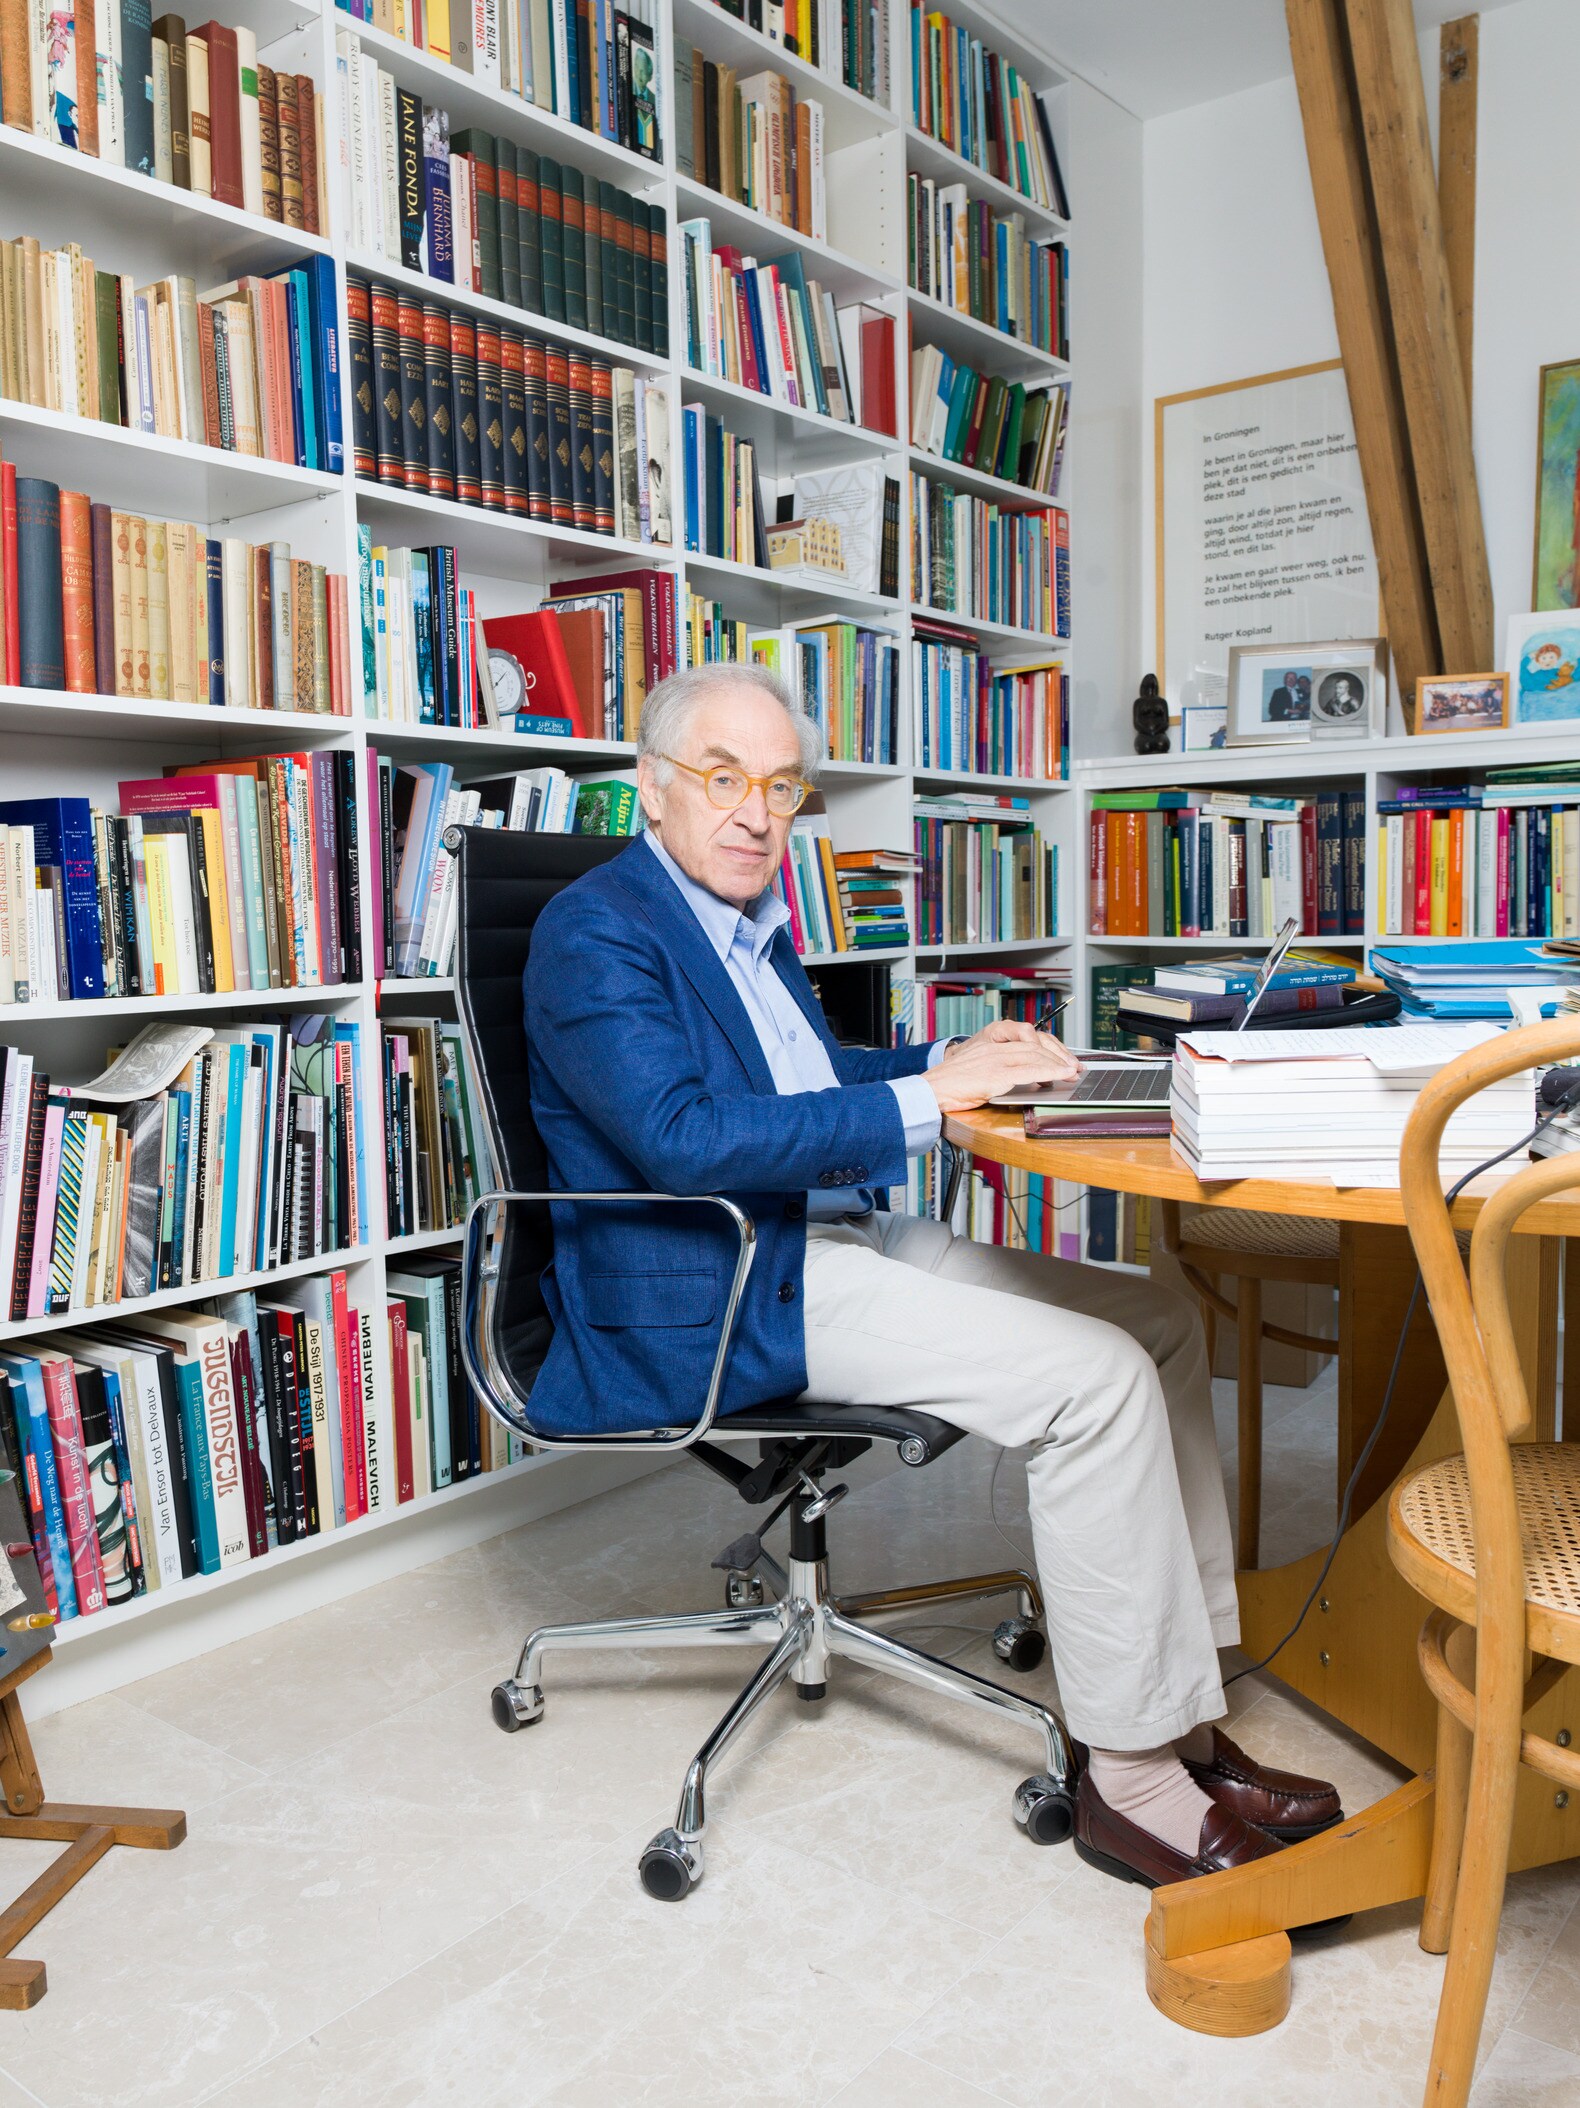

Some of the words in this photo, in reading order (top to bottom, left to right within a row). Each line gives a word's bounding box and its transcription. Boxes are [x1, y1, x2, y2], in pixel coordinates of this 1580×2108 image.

[487, 27, 496, 60] BLAIR
[350, 44, 360, 86] ROMY
[384, 79, 394, 127] MARIA
[401, 94, 416, 145] JANE
[352, 94, 363, 183] SCHNEIDER
[384, 129, 395, 181] CALLAS
[405, 148, 418, 217] FONDA
[432, 187, 444, 262] BERNHARD
[1203, 434, 1212, 443] In
[1214, 426, 1260, 442] Groningen
[1204, 459, 1212, 468] Je
[1215, 454, 1235, 465] bent
[1237, 452, 1246, 460] in
[1301, 437, 1324, 448] maar
[1326, 432, 1345, 442] hier
[1204, 469, 1220, 478] ben
[1222, 467, 1231, 478] je
[1233, 463, 1248, 474] dat
[1272, 456, 1284, 466] dit
[1287, 455, 1294, 464] is
[1296, 452, 1314, 462] een
[1227, 476, 1240, 487] dit
[1242, 475, 1248, 484] is
[1251, 472, 1268, 482] een
[1270, 464, 1303, 480] gedicht
[1306, 463, 1315, 472] in
[1204, 493, 1224, 502] deze
[1226, 488, 1246, 498] stad
[1204, 514, 1234, 526] waarin
[1236, 512, 1244, 522] je
[1247, 509, 1254, 519] al
[1258, 506, 1271, 516] die
[1274, 504, 1296, 516] jaren
[1299, 497, 1327, 509] kwam
[1330, 496, 1342, 504] en
[1228, 523, 1248, 534] door
[1251, 518, 1274, 532] altijd
[1298, 509, 1321, 522] altijd
[361, 535, 370, 565] Groot
[1204, 536, 1226, 549] altijd
[1256, 528, 1284, 540] totdat
[1286, 528, 1294, 538] je
[1296, 524, 1314, 534] hier
[1234, 548, 1244, 556] en
[1247, 544, 1258, 554] dit
[445, 548, 453, 580] British
[1205, 576, 1214, 584] Je
[1216, 572, 1242, 582] kwam
[1244, 570, 1256, 578] en
[1258, 566, 1278, 578] gaat
[1281, 562, 1303, 572] weer
[1332, 554, 1349, 565] ook
[1204, 587, 1216, 595] Zo
[1218, 584, 1230, 594] zal
[1232, 582, 1246, 592] het
[1250, 577, 1280, 590] blijven
[1282, 572, 1311, 584] tussen
[1335, 567, 1343, 576] ik
[1346, 565, 1364, 574] ben
[446, 581, 456, 626] Museum
[1204, 598, 1220, 607] een
[1222, 590, 1272, 604] onbekende
[449, 626, 457, 659] Guide
[1204, 630, 1233, 642] Rutger
[1236, 624, 1272, 639] Kopland
[616, 788, 632, 824] Mijn
[346, 797, 358, 846] ANDREW
[428, 800, 446, 872] INTERIEURDESIGN
[348, 848, 359, 881] LLOYD
[432, 860, 446, 895] WOON
[328, 870, 336, 910] Nederlands
[350, 884, 360, 934] WEBBER
[2, 914, 10, 957] MUZIEK
[18, 917, 26, 964] MOZART
[20, 1064, 29, 1087] KLEINE
[17, 1089, 27, 1115] DINGEN
[17, 1116, 25, 1129] MET
[181, 1116, 189, 1142] ARTI
[14, 1131, 23, 1153] LIEFDE
[52, 1294, 70, 1303] DUF
[310, 1328, 319, 1340] De
[310, 1342, 322, 1370] Stijl
[362, 1315, 374, 1401] МАЛЕВИЧ
[192, 1380, 201, 1395] La
[312, 1372, 325, 1422] 1917-1931
[146, 1387, 162, 1441] Delvaux
[193, 1396, 204, 1431] France
[299, 1398, 312, 1438] STIJL
[343, 1375, 351, 1434] PROPAGANDA
[44, 1451, 53, 1463] De
[67, 1437, 81, 1470] Kunst
[152, 1445, 164, 1465] tot
[197, 1434, 206, 1453] aux
[346, 1437, 354, 1475] POSTERS
[44, 1464, 56, 1485] Weg
[72, 1472, 83, 1485] in
[197, 1455, 210, 1500] Pays-Bas
[367, 1421, 379, 1507] MALEVICH
[49, 1486, 57, 1505] naar
[75, 1487, 84, 1500] de
[155, 1469, 168, 1506] Ensor
[52, 1507, 60, 1517] de
[77, 1503, 88, 1532] lucht
[161, 1508, 171, 1535] Van
[55, 1520, 65, 1549] Hemel
[224, 1541, 245, 1556] icob
